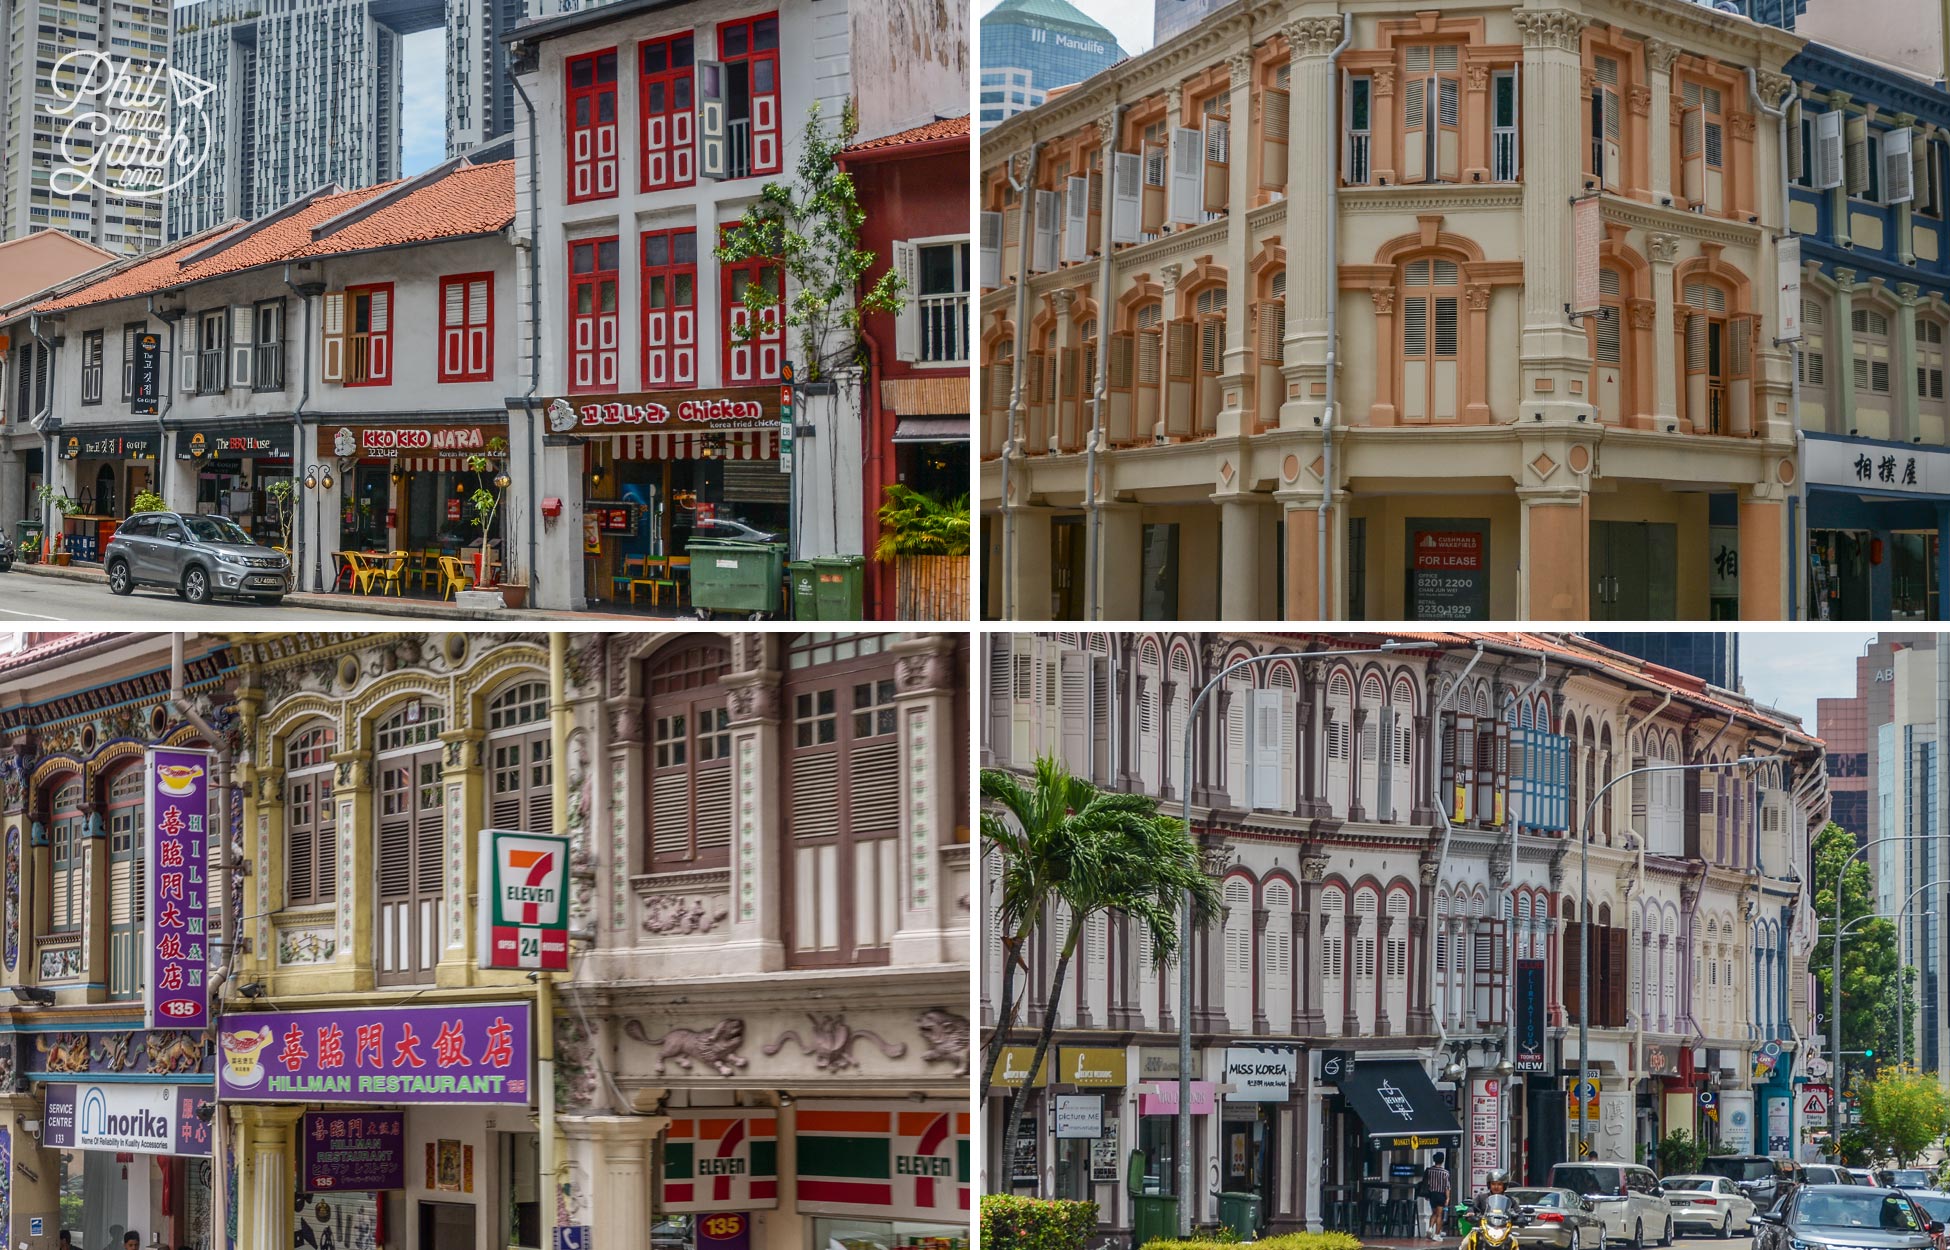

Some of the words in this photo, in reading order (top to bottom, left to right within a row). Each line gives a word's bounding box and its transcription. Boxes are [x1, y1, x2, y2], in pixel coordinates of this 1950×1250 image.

[1055, 34, 1104, 54] Manulife
[581, 402, 670, 426] 꼬꼬나라
[678, 398, 762, 422] Chicken
[732, 420, 752, 428] fried
[216, 438, 229, 450] The
[229, 437, 247, 450] BBQ
[432, 428, 484, 449] NARA
[1854, 452, 1918, 485] 相撲屋
[1419, 556, 1440, 565] FOR
[1443, 557, 1476, 565] LEASE
[1418, 579, 1442, 587] 8201
[1445, 579, 1472, 587] 2200
[1418, 605, 1444, 613] 9230
[1446, 606, 1471, 614] 1929
[508, 850, 554, 924] 7
[157, 804, 186, 990] 喜臨門大飯店
[186, 814, 204, 988] HILLMAN
[520, 938, 538, 957] 24
[167, 1001, 194, 1015] 135
[278, 1016, 514, 1072] 喜臨門大飯店
[1229, 1064, 1254, 1075] MISS
[1255, 1064, 1287, 1075] KOREA
[268, 1076, 350, 1092] HILLMAN
[358, 1075, 505, 1094] RESTAURANT
[49, 1104, 72, 1114] SERVICE
[48, 1117, 72, 1128] CENTRE
[108, 1109, 168, 1138] norika
[55, 1134, 64, 1144] 133
[182, 1122, 207, 1143] 中心
[82, 1136, 93, 1144] Name
[100, 1138, 119, 1148] Reliability
[125, 1139, 140, 1149] Kuality
[141, 1140, 168, 1149] Accessories
[330, 1139, 381, 1149] HILLMAN
[317, 1151, 393, 1162] RESTAURANT
[699, 1118, 744, 1200] 7
[897, 1112, 949, 1208] 7
[706, 1217, 739, 1235] 135
